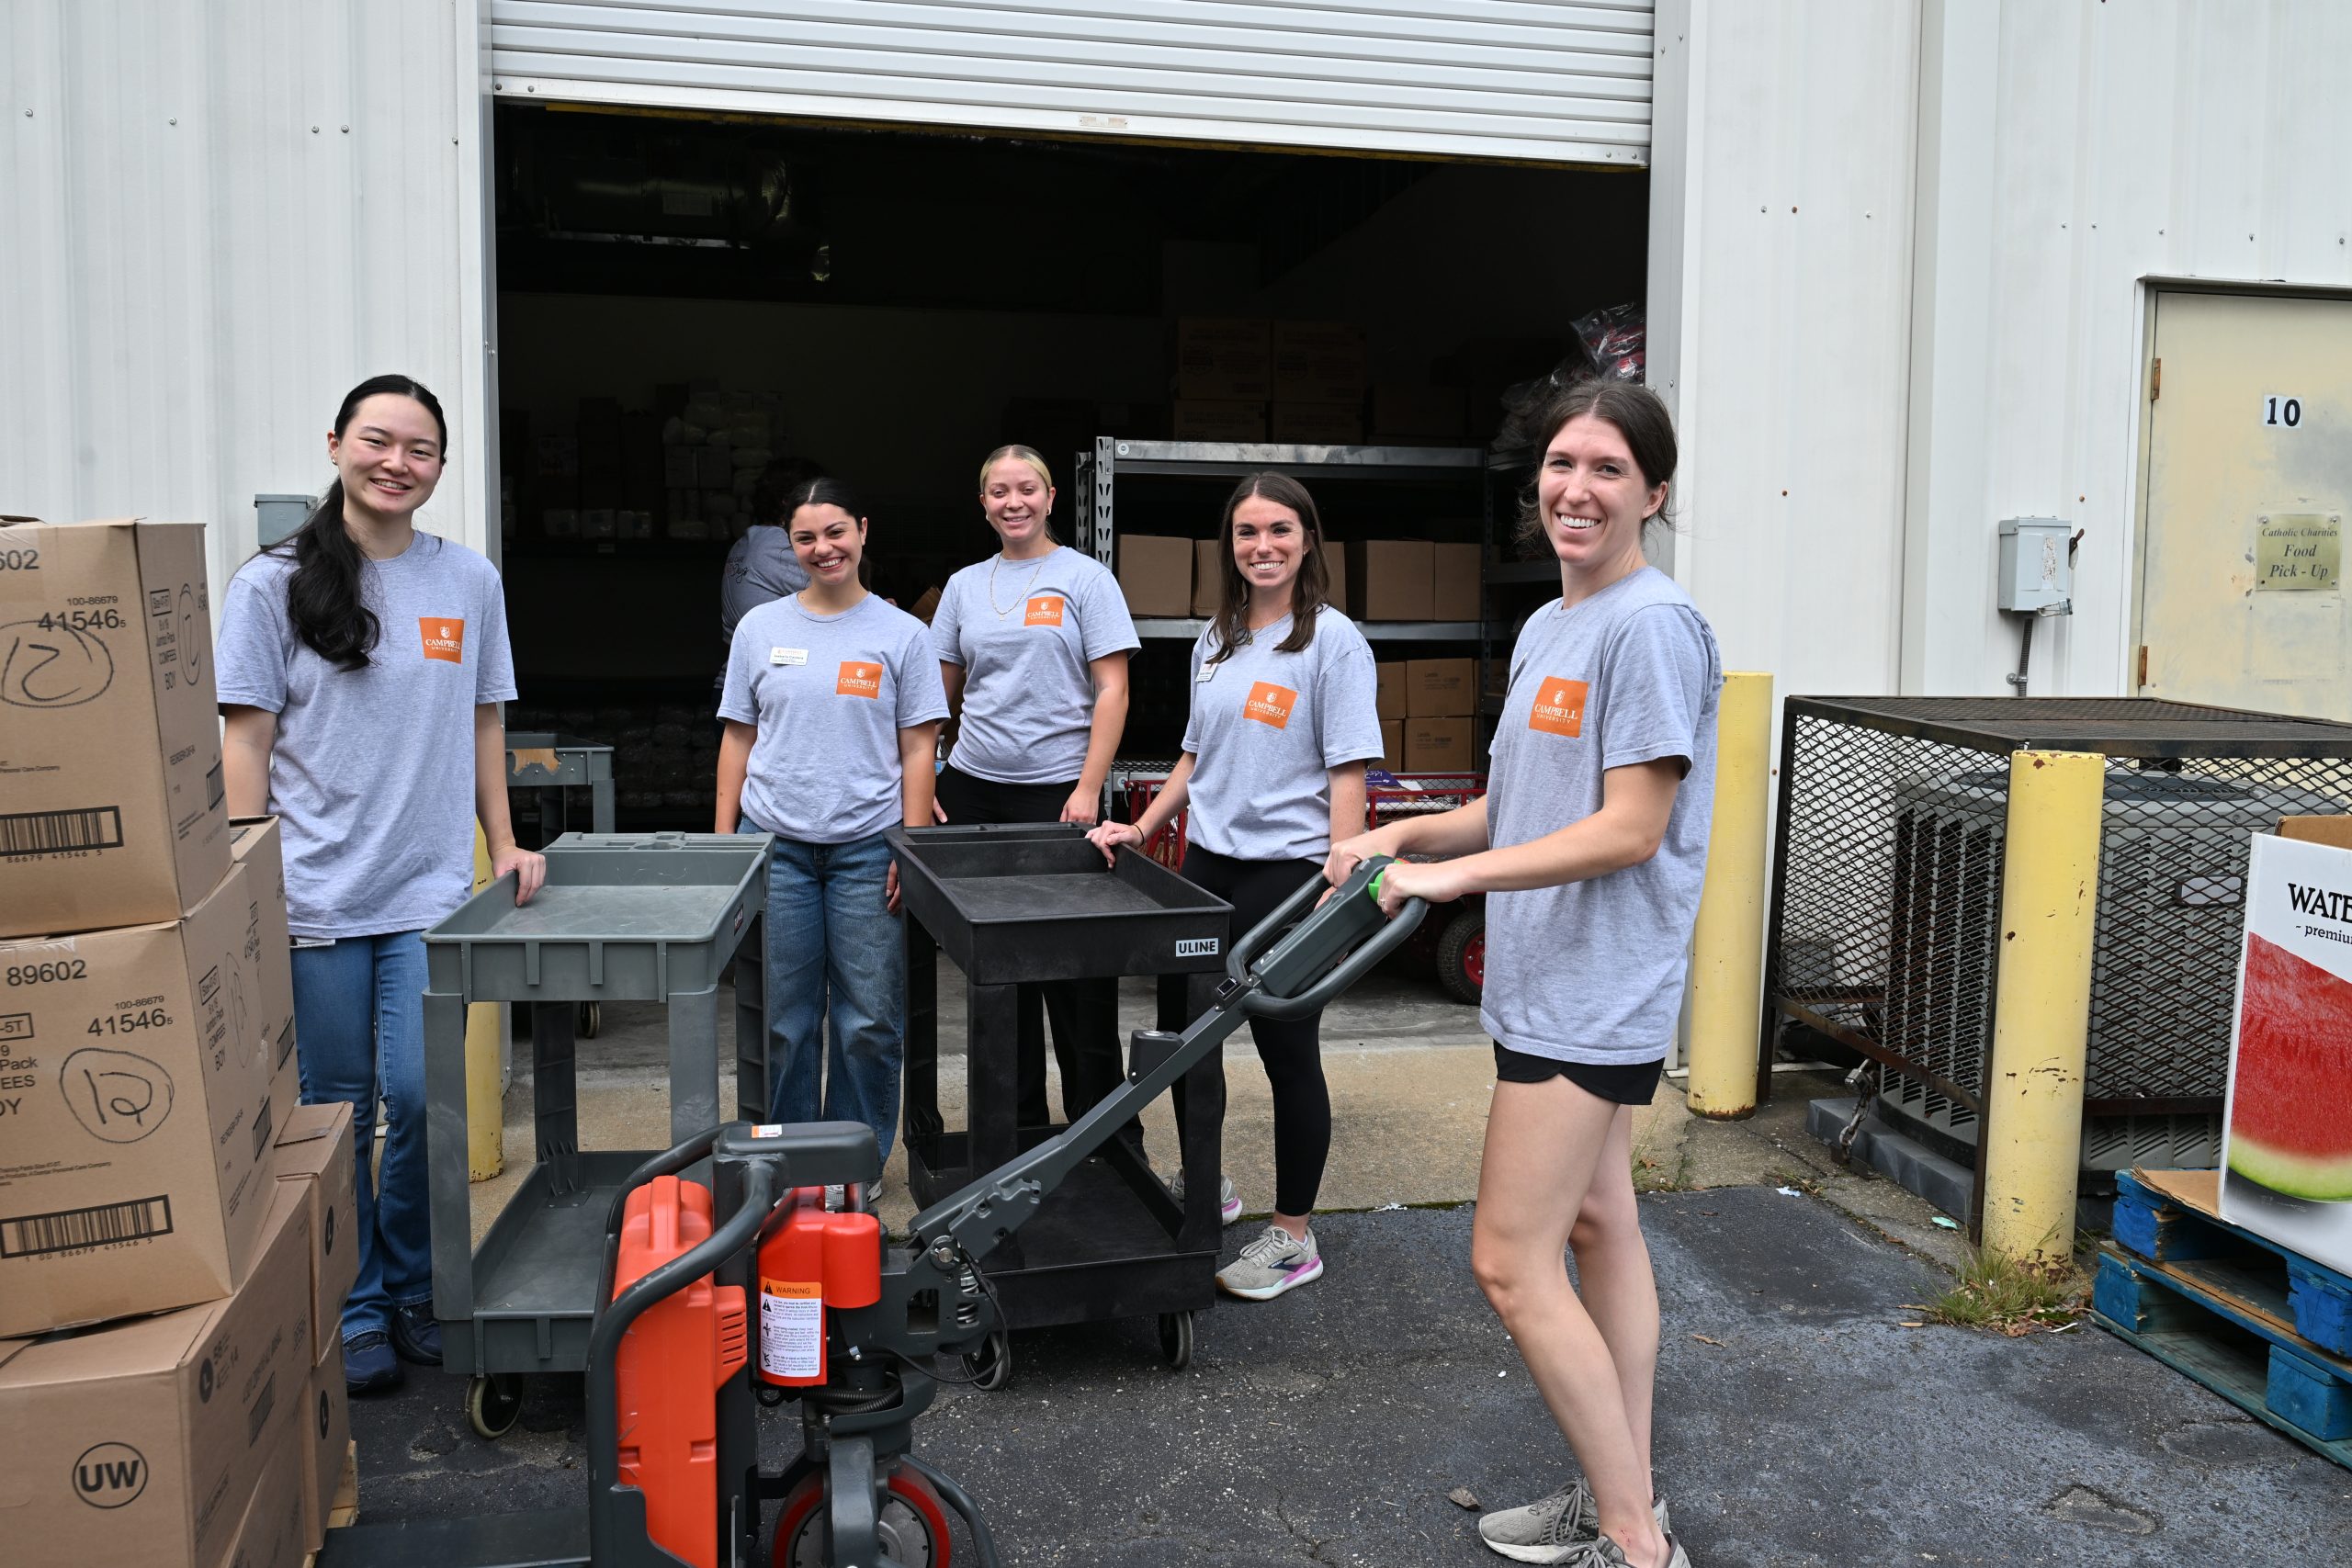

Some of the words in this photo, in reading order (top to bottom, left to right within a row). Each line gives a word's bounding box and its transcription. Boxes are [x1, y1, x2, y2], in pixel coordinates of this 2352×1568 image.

[2267, 398, 2301, 427] 10
[2262, 527, 2299, 537] Catholic
[2301, 527, 2338, 537] Charities
[2284, 544, 2317, 557] Food
[2269, 564, 2297, 578] Pick
[2311, 564, 2328, 581] Up
[840, 677, 877, 688] CAMPBELL
[1248, 699, 1287, 717] CAMPBELL
[1534, 704, 1578, 720] CAMPBELL
[7, 854, 43, 863] 86679
[51, 851, 88, 860] 41546
[2304, 924, 2352, 945] premiu
[1179, 941, 1216, 954] ULINE
[7, 959, 87, 987] 89602
[115, 996, 164, 1010] 100-86679
[0, 1057, 40, 1072] Pack
[1, 1075, 36, 1090] EES
[775, 1286, 811, 1294] WARNING
[79, 1459, 140, 1493] UW
